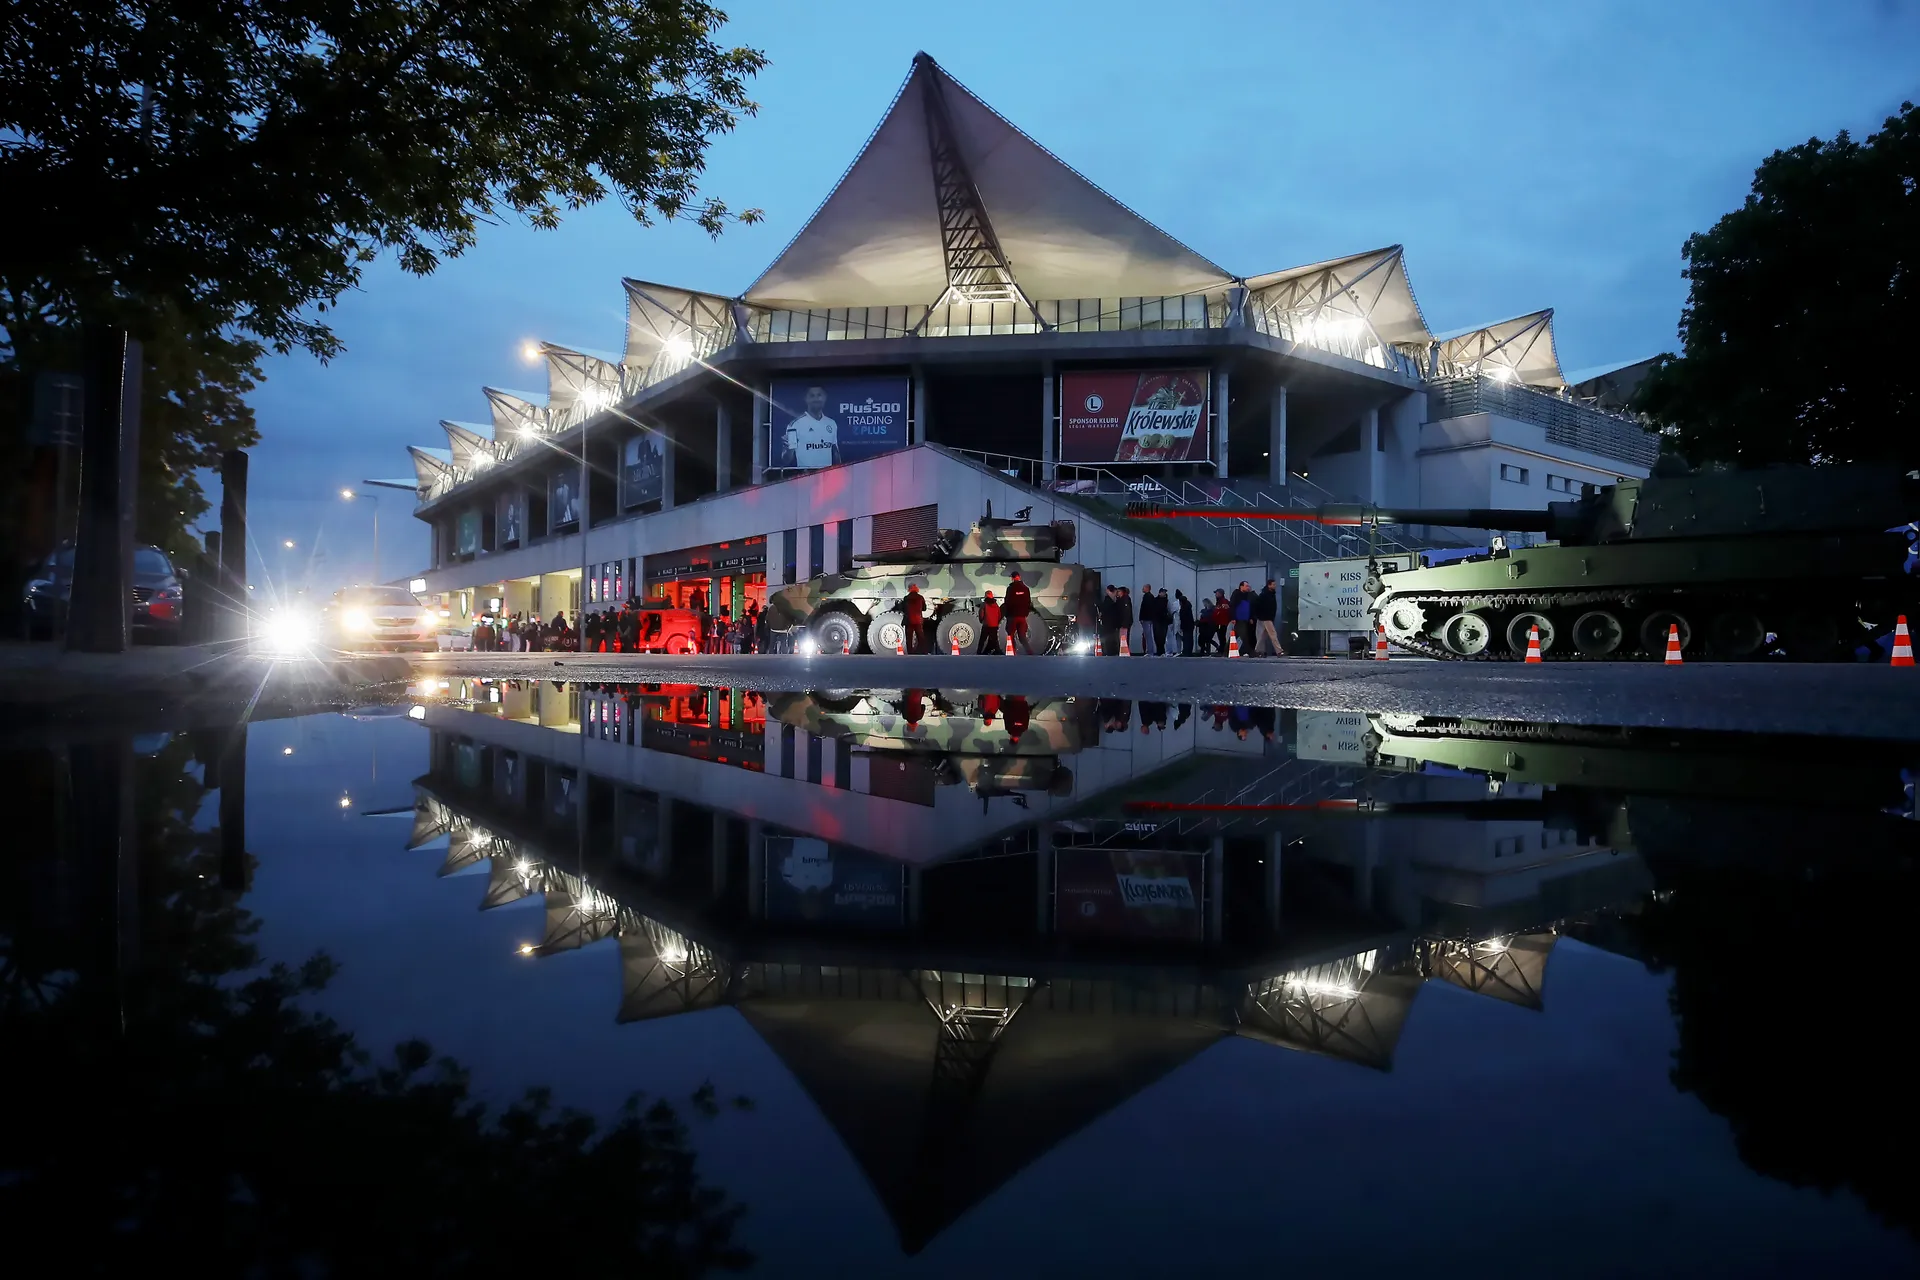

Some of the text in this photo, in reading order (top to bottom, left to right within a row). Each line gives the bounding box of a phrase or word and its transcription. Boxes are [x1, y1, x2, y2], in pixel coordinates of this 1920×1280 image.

[839, 398, 901, 414] Plus500
[847, 415, 893, 425] TRADING
[1069, 417, 1098, 425] SPONSOR
[1125, 409, 1197, 436] Królewskie
[860, 425, 887, 435] PLUS
[1128, 482, 1162, 491] GRILL
[1340, 571, 1362, 582] KISS
[1342, 584, 1359, 593] and
[1337, 597, 1363, 606] WISH
[1337, 609, 1363, 618] LUCK
